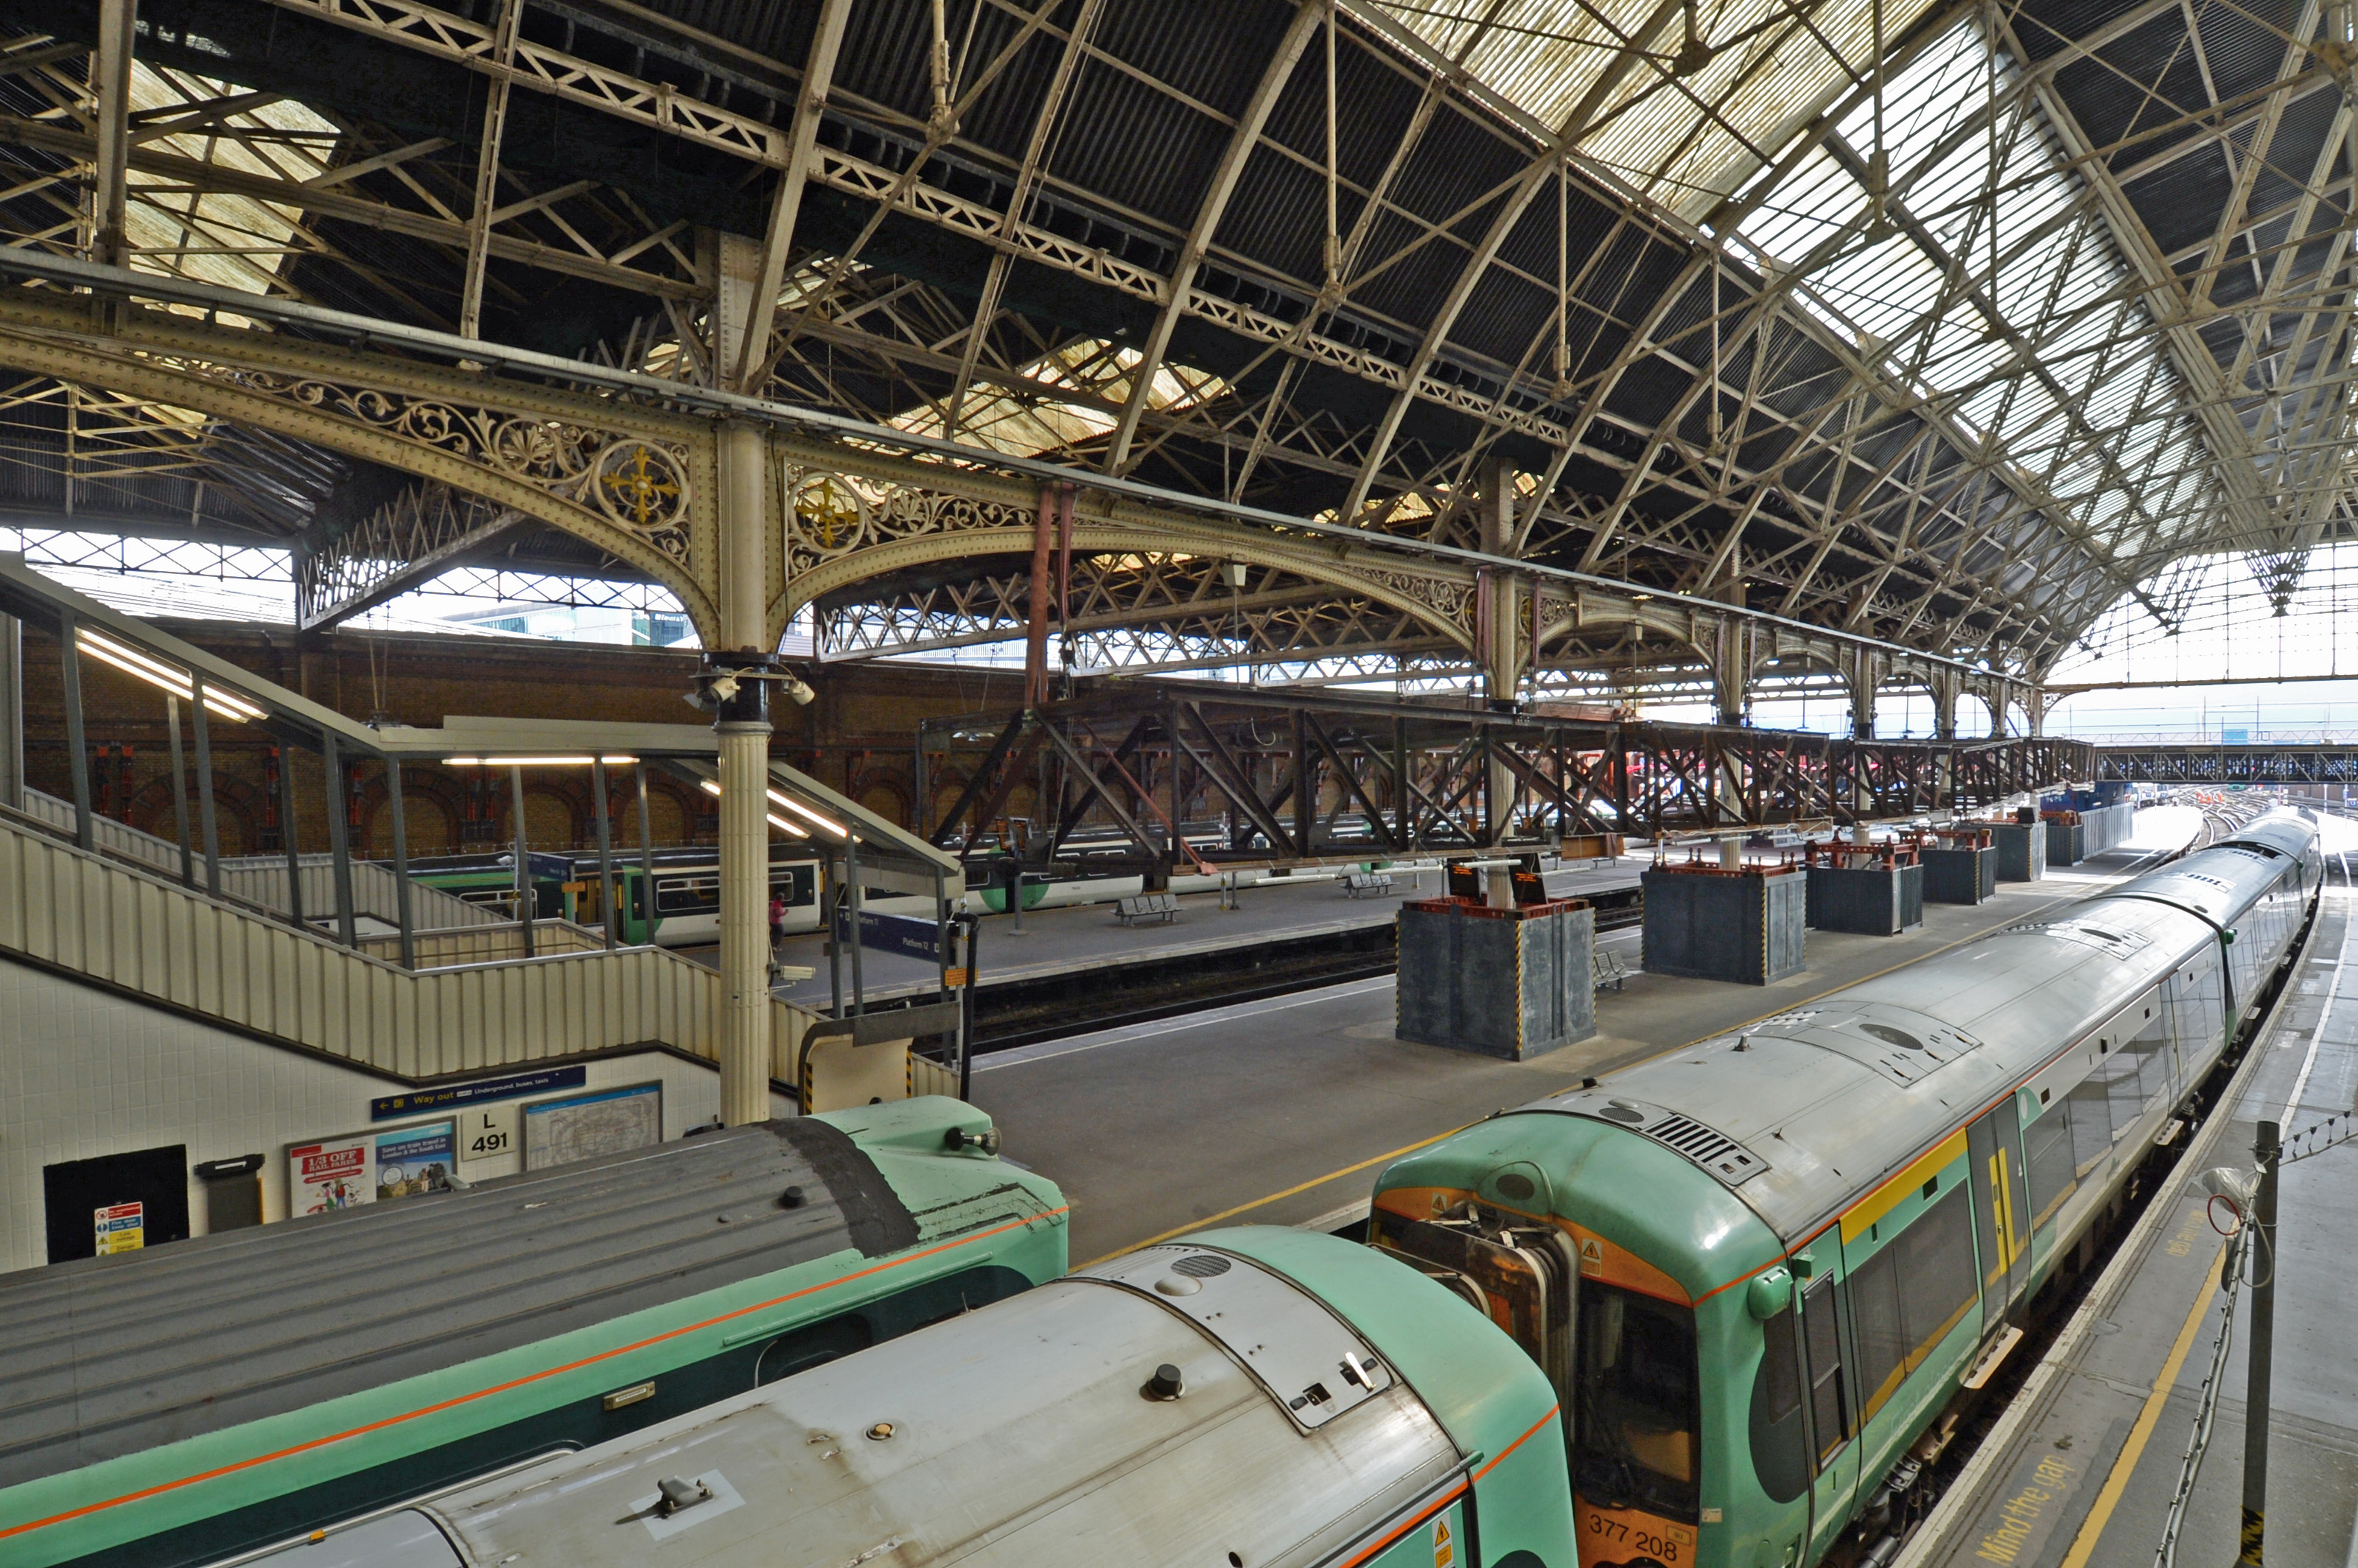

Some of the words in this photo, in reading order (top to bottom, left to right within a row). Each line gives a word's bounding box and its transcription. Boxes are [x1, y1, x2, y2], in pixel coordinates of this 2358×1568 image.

[902, 937, 923, 948] Platform
[923, 941, 928, 951] 12
[413, 1094, 435, 1105] Way
[437, 1091, 455, 1101] out
[483, 1113, 496, 1129] L
[382, 1146, 397, 1154] Save
[471, 1133, 508, 1152] 491
[309, 1155, 327, 1166] 1/3
[329, 1150, 357, 1163] OFF
[382, 1150, 403, 1159] London
[331, 1158, 357, 1167] FARES
[1975, 1514, 2033, 1567] Mind
[2004, 1487, 2051, 1518] the
[2032, 1455, 2075, 1490] gap
[1589, 1514, 1628, 1542] 377
[1635, 1531, 1677, 1561] 208
